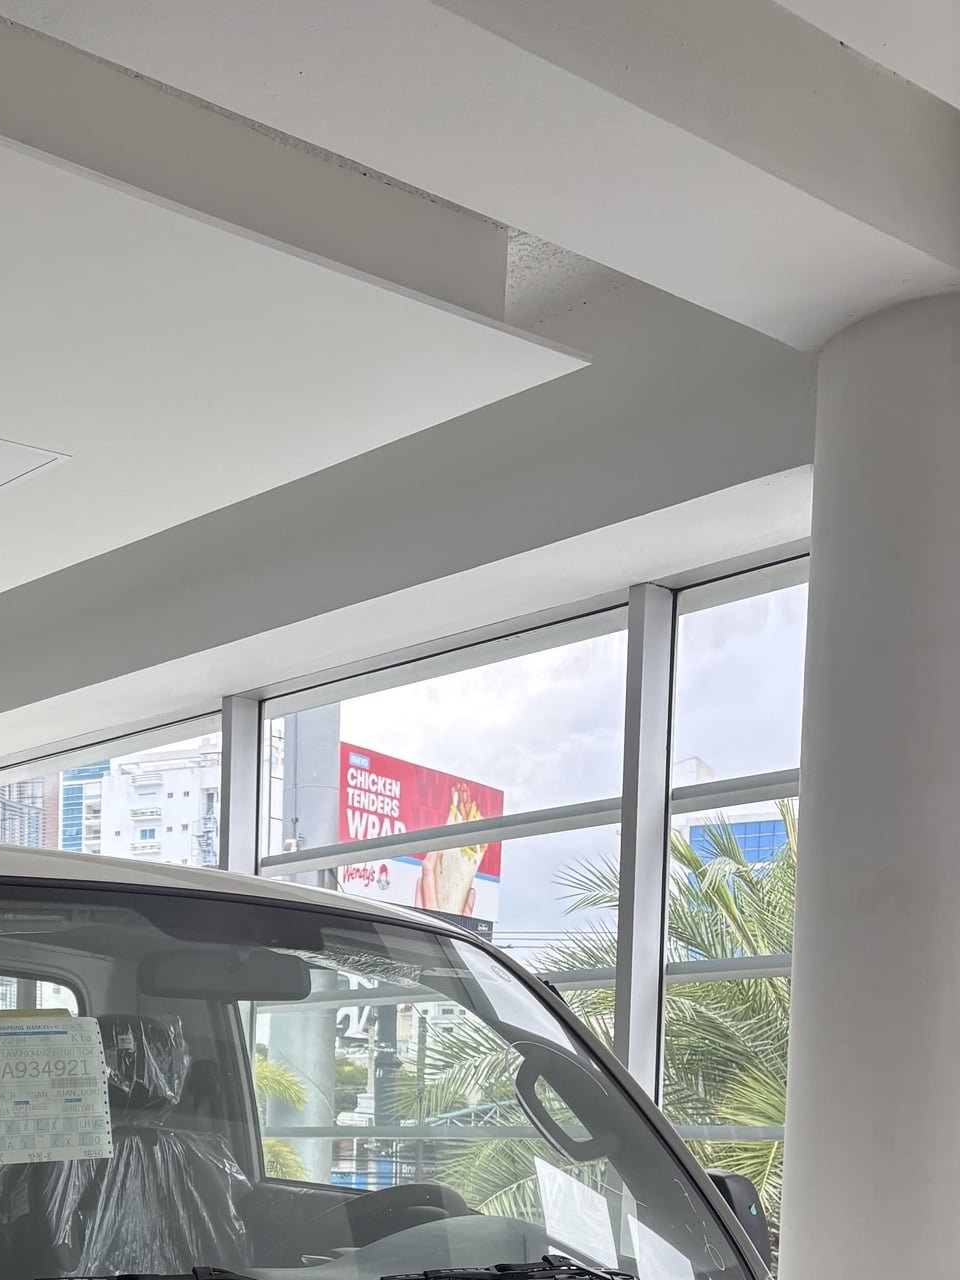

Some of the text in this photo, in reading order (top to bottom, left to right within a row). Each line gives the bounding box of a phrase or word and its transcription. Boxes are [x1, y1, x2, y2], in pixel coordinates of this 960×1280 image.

[347, 768, 400, 799] CHICKEN
[347, 788, 400, 817] TENDERS
[343, 863, 376, 887] Wendy's
[71, 1033, 92, 1043] Kia
